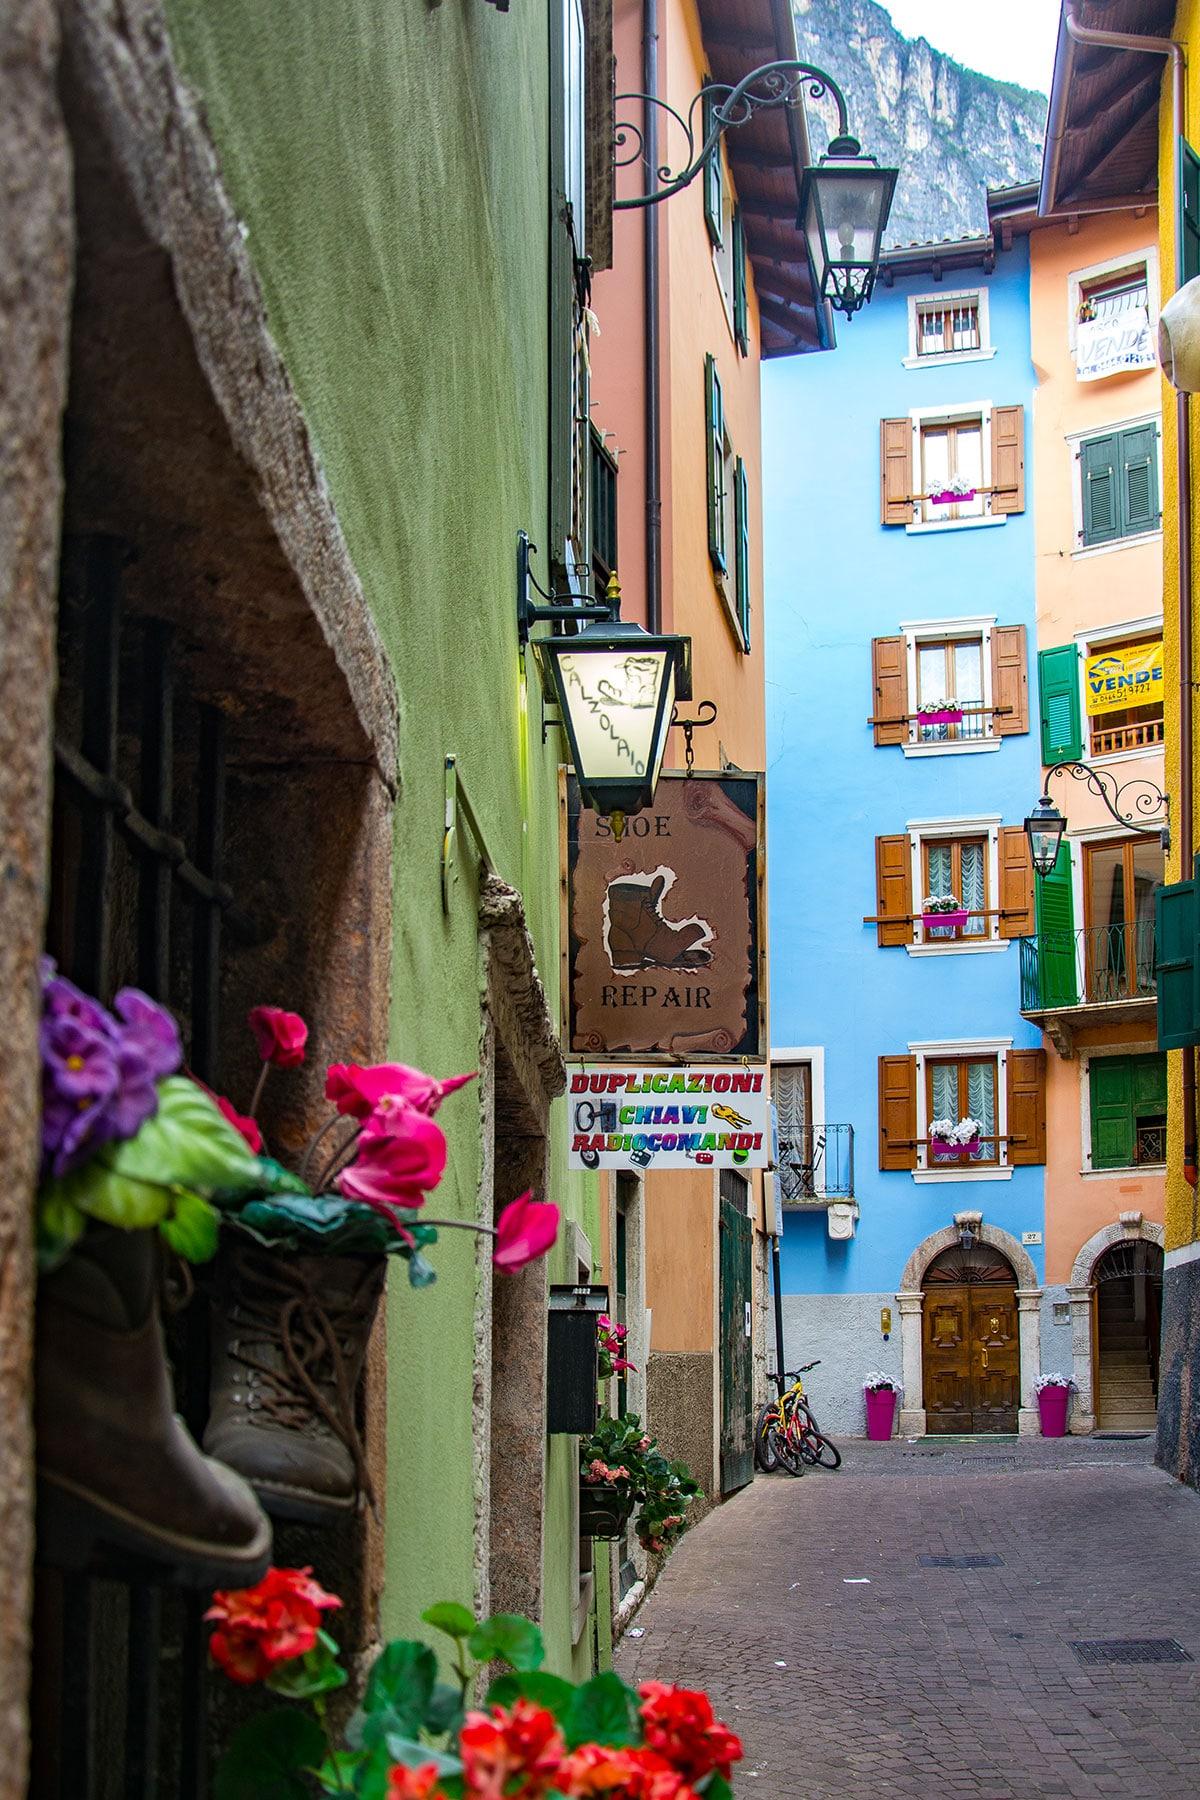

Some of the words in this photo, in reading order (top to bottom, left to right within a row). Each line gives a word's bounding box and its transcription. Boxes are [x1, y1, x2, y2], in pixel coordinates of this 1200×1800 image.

[1090, 667, 1163, 694] VENDE
[560, 655, 645, 775] CALZOLAIO
[600, 985, 712, 1008] REPAIR
[569, 1073, 764, 1094] DUPLICAZIONI
[618, 1104, 709, 1125] CHIAVI
[571, 1132, 764, 1152] RADIOCOMANDI
